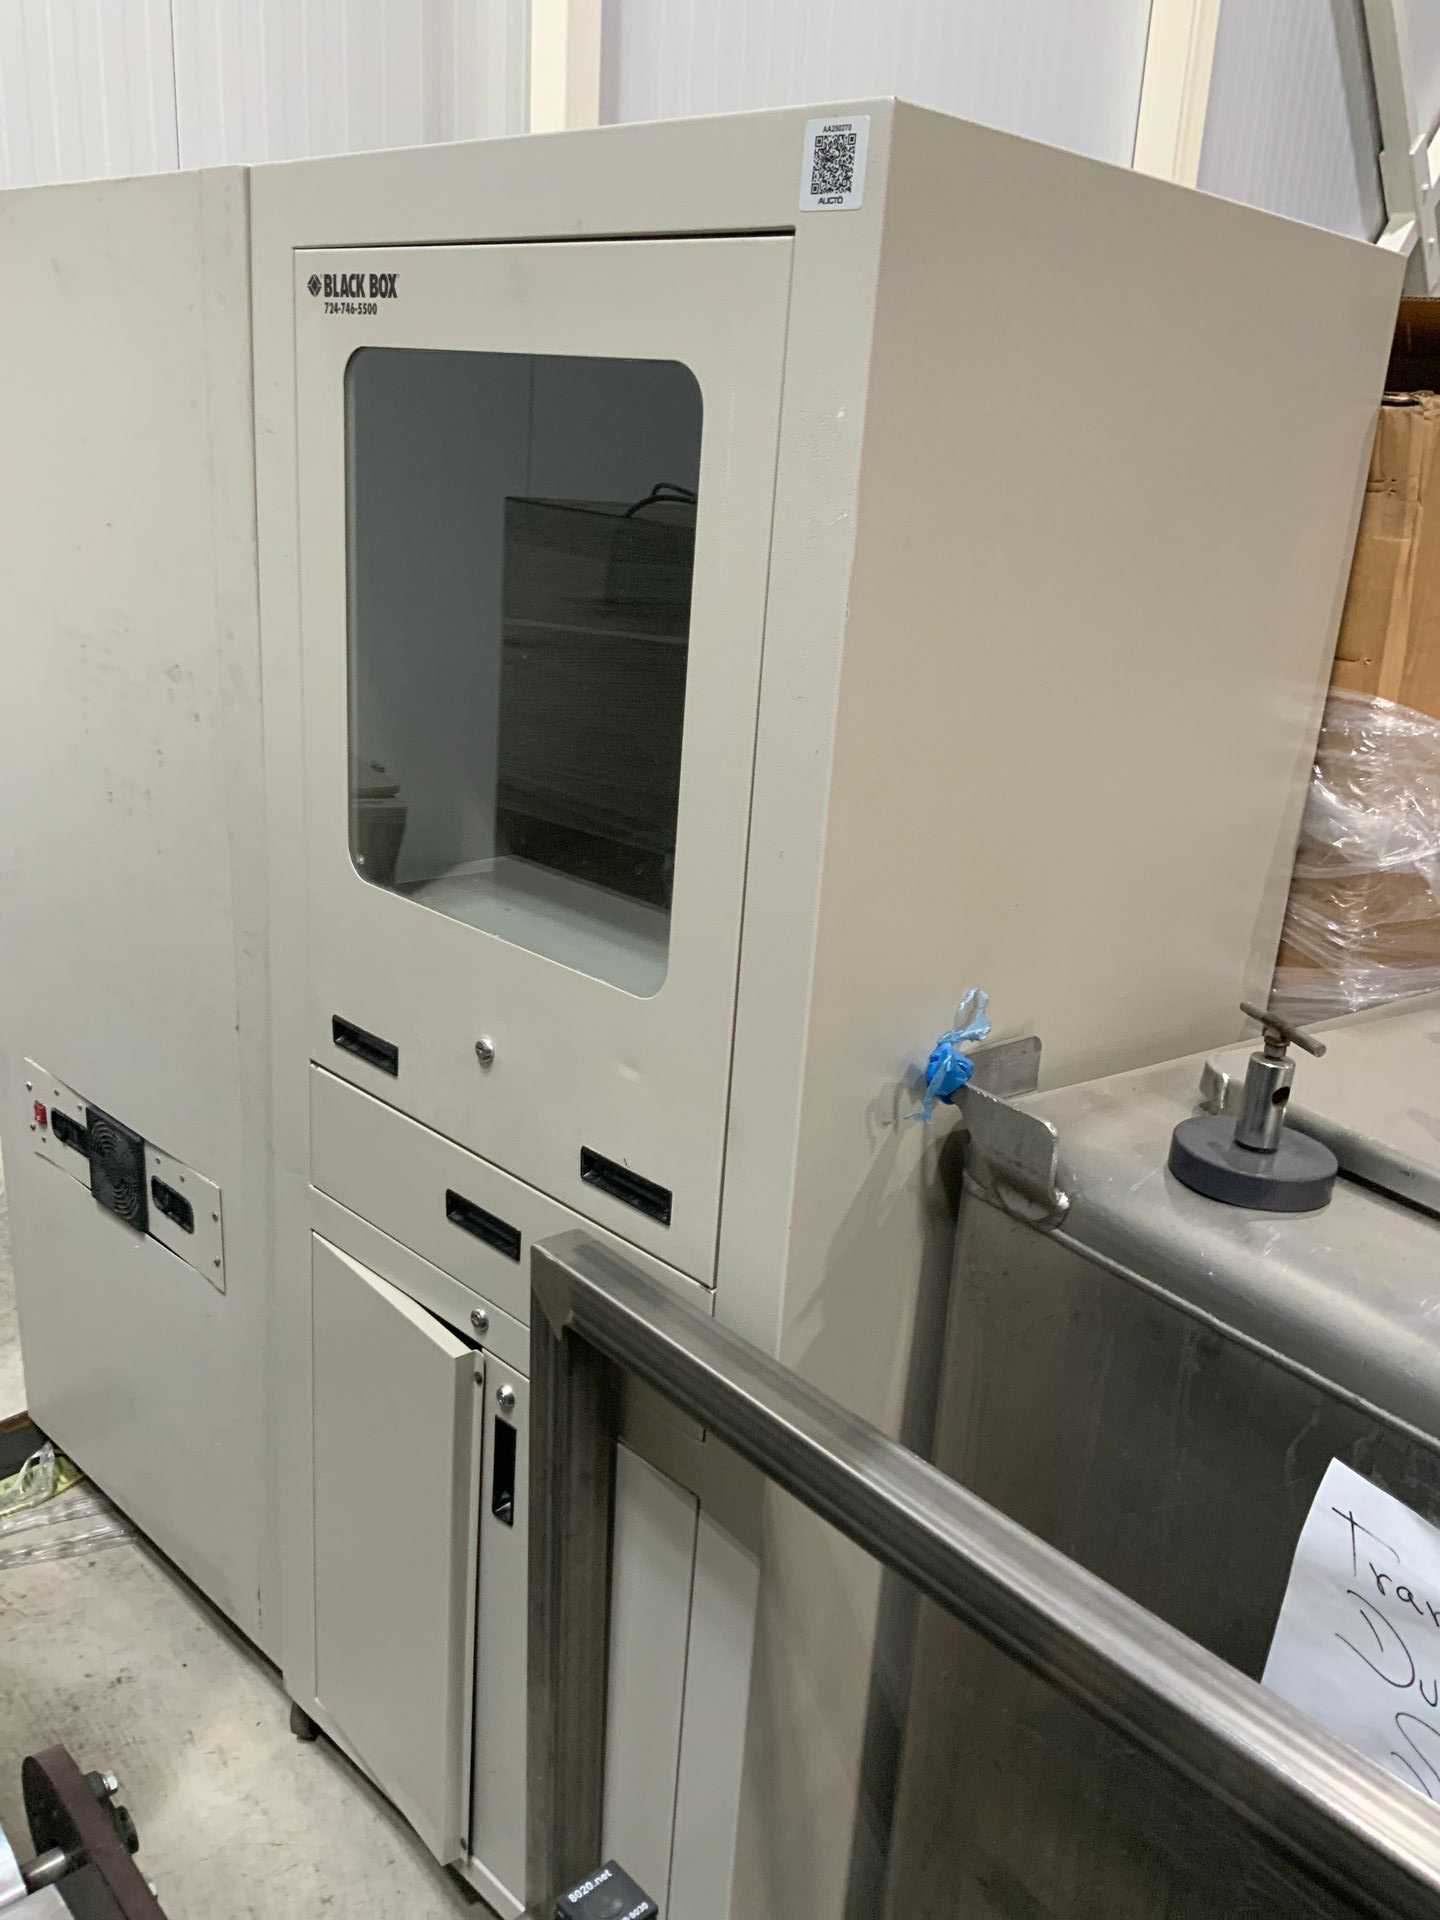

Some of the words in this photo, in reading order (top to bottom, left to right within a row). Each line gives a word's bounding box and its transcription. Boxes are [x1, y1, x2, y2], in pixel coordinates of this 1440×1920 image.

[324, 273, 366, 298] BLACK
[369, 273, 398, 298] BOX
[324, 302, 378, 315] 724-746-5500
